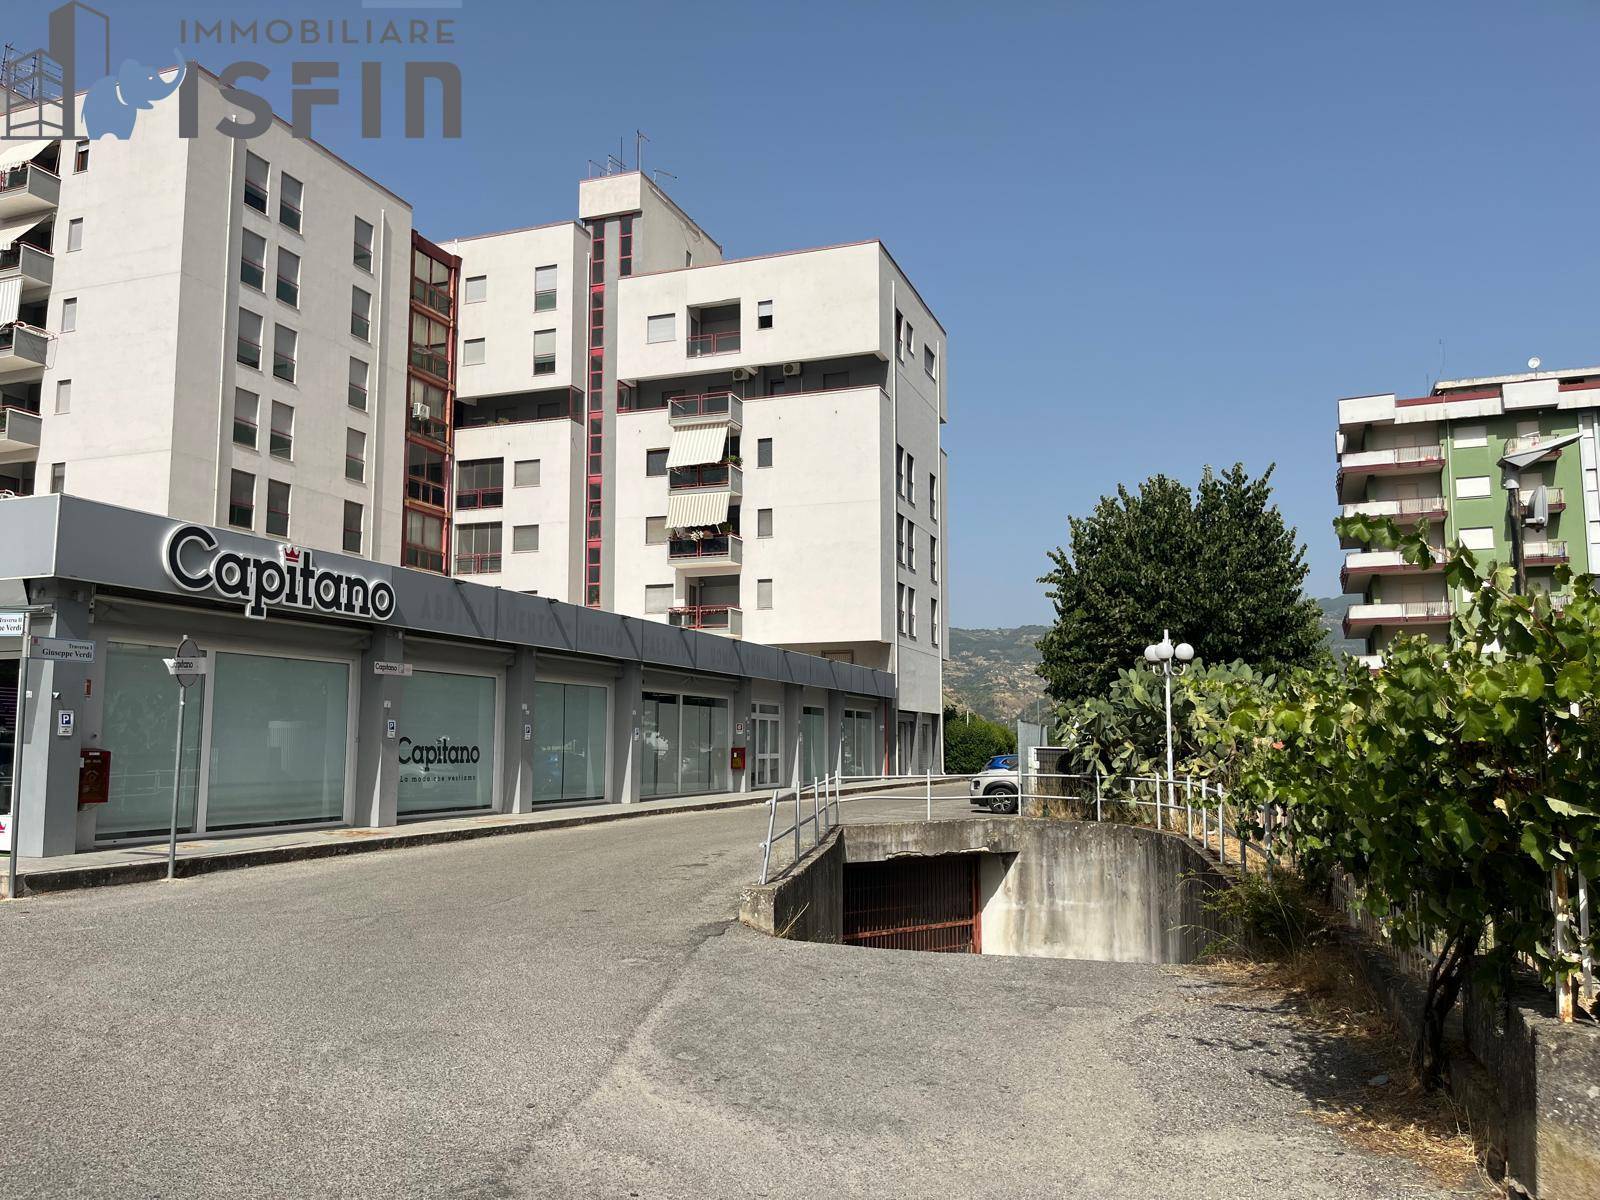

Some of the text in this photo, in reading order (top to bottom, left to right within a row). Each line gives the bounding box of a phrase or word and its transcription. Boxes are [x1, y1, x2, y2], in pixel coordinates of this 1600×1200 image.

[163, 523, 396, 619] Capitano
[42, 648, 92, 659] Giuseppe Verdi
[398, 737, 480, 772] Capitano
